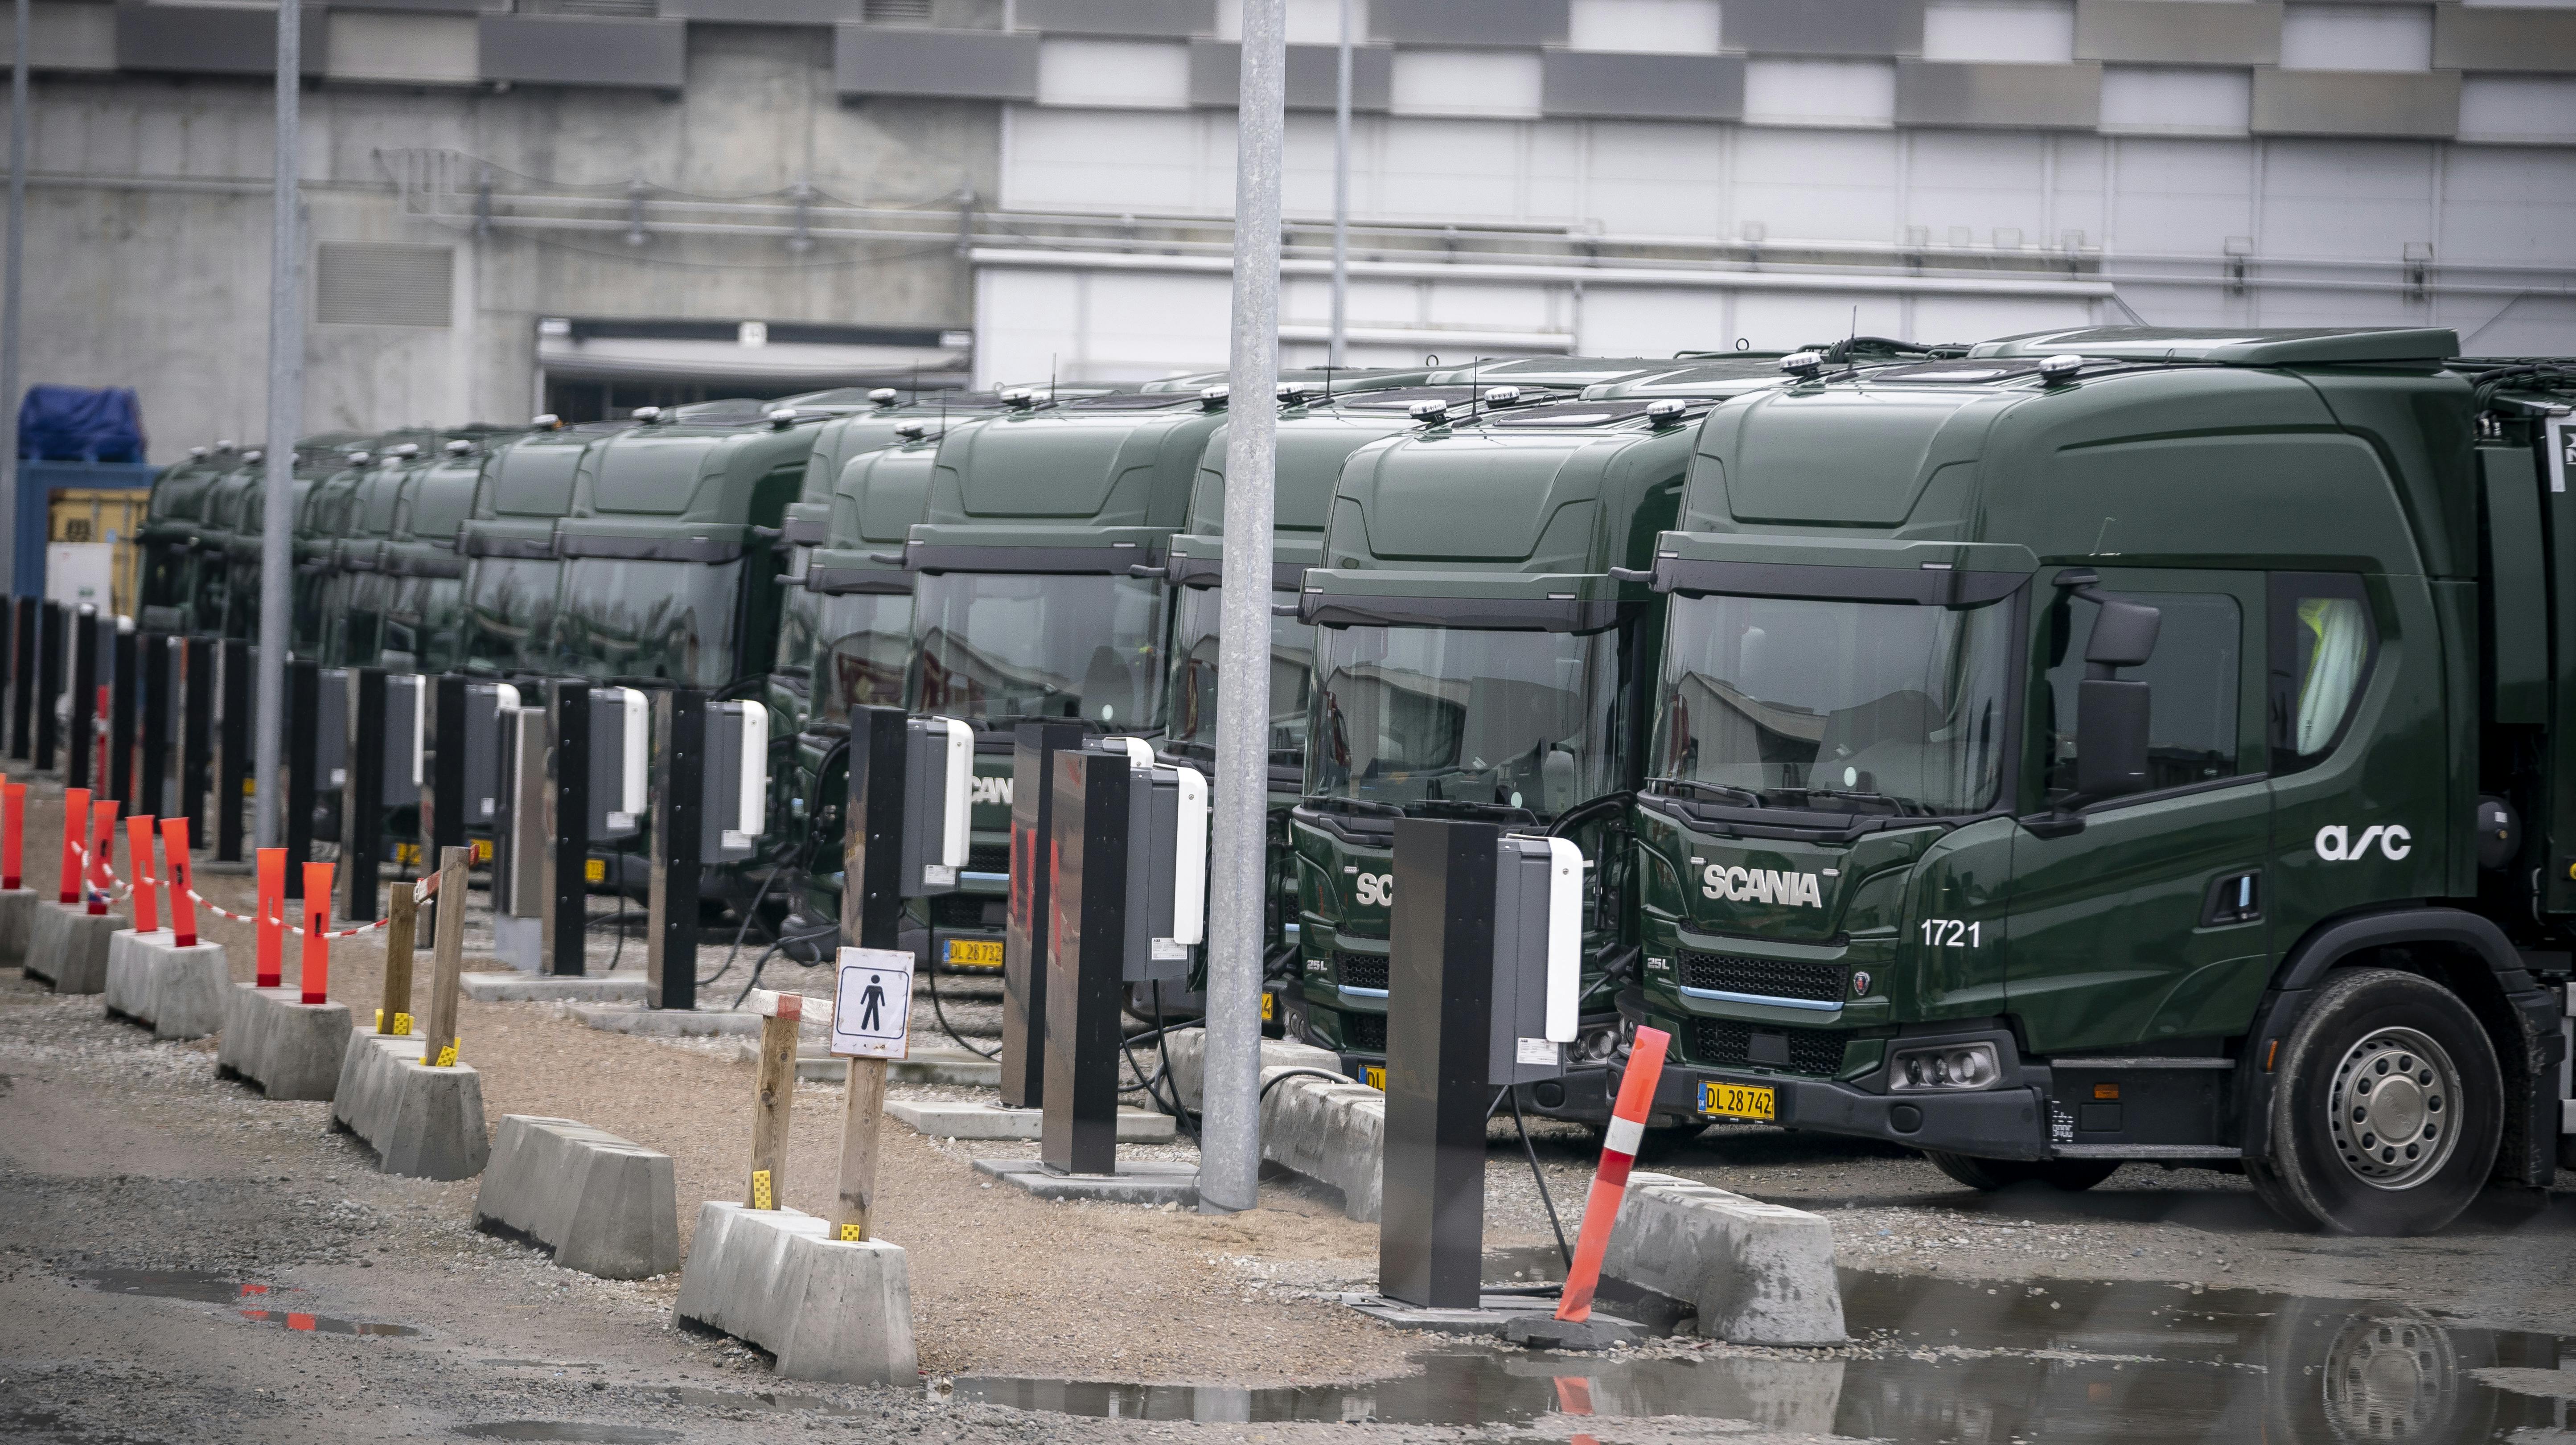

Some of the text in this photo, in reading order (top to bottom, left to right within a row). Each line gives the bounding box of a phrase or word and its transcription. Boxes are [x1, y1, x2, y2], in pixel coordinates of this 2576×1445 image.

[971, 776, 1014, 803] CAN
[1703, 864, 1822, 908] SCANIA
[1921, 919, 1980, 948] 1721
[1368, 1071, 1384, 1092] DL
[1707, 1087, 1772, 1114] DL 28 742
